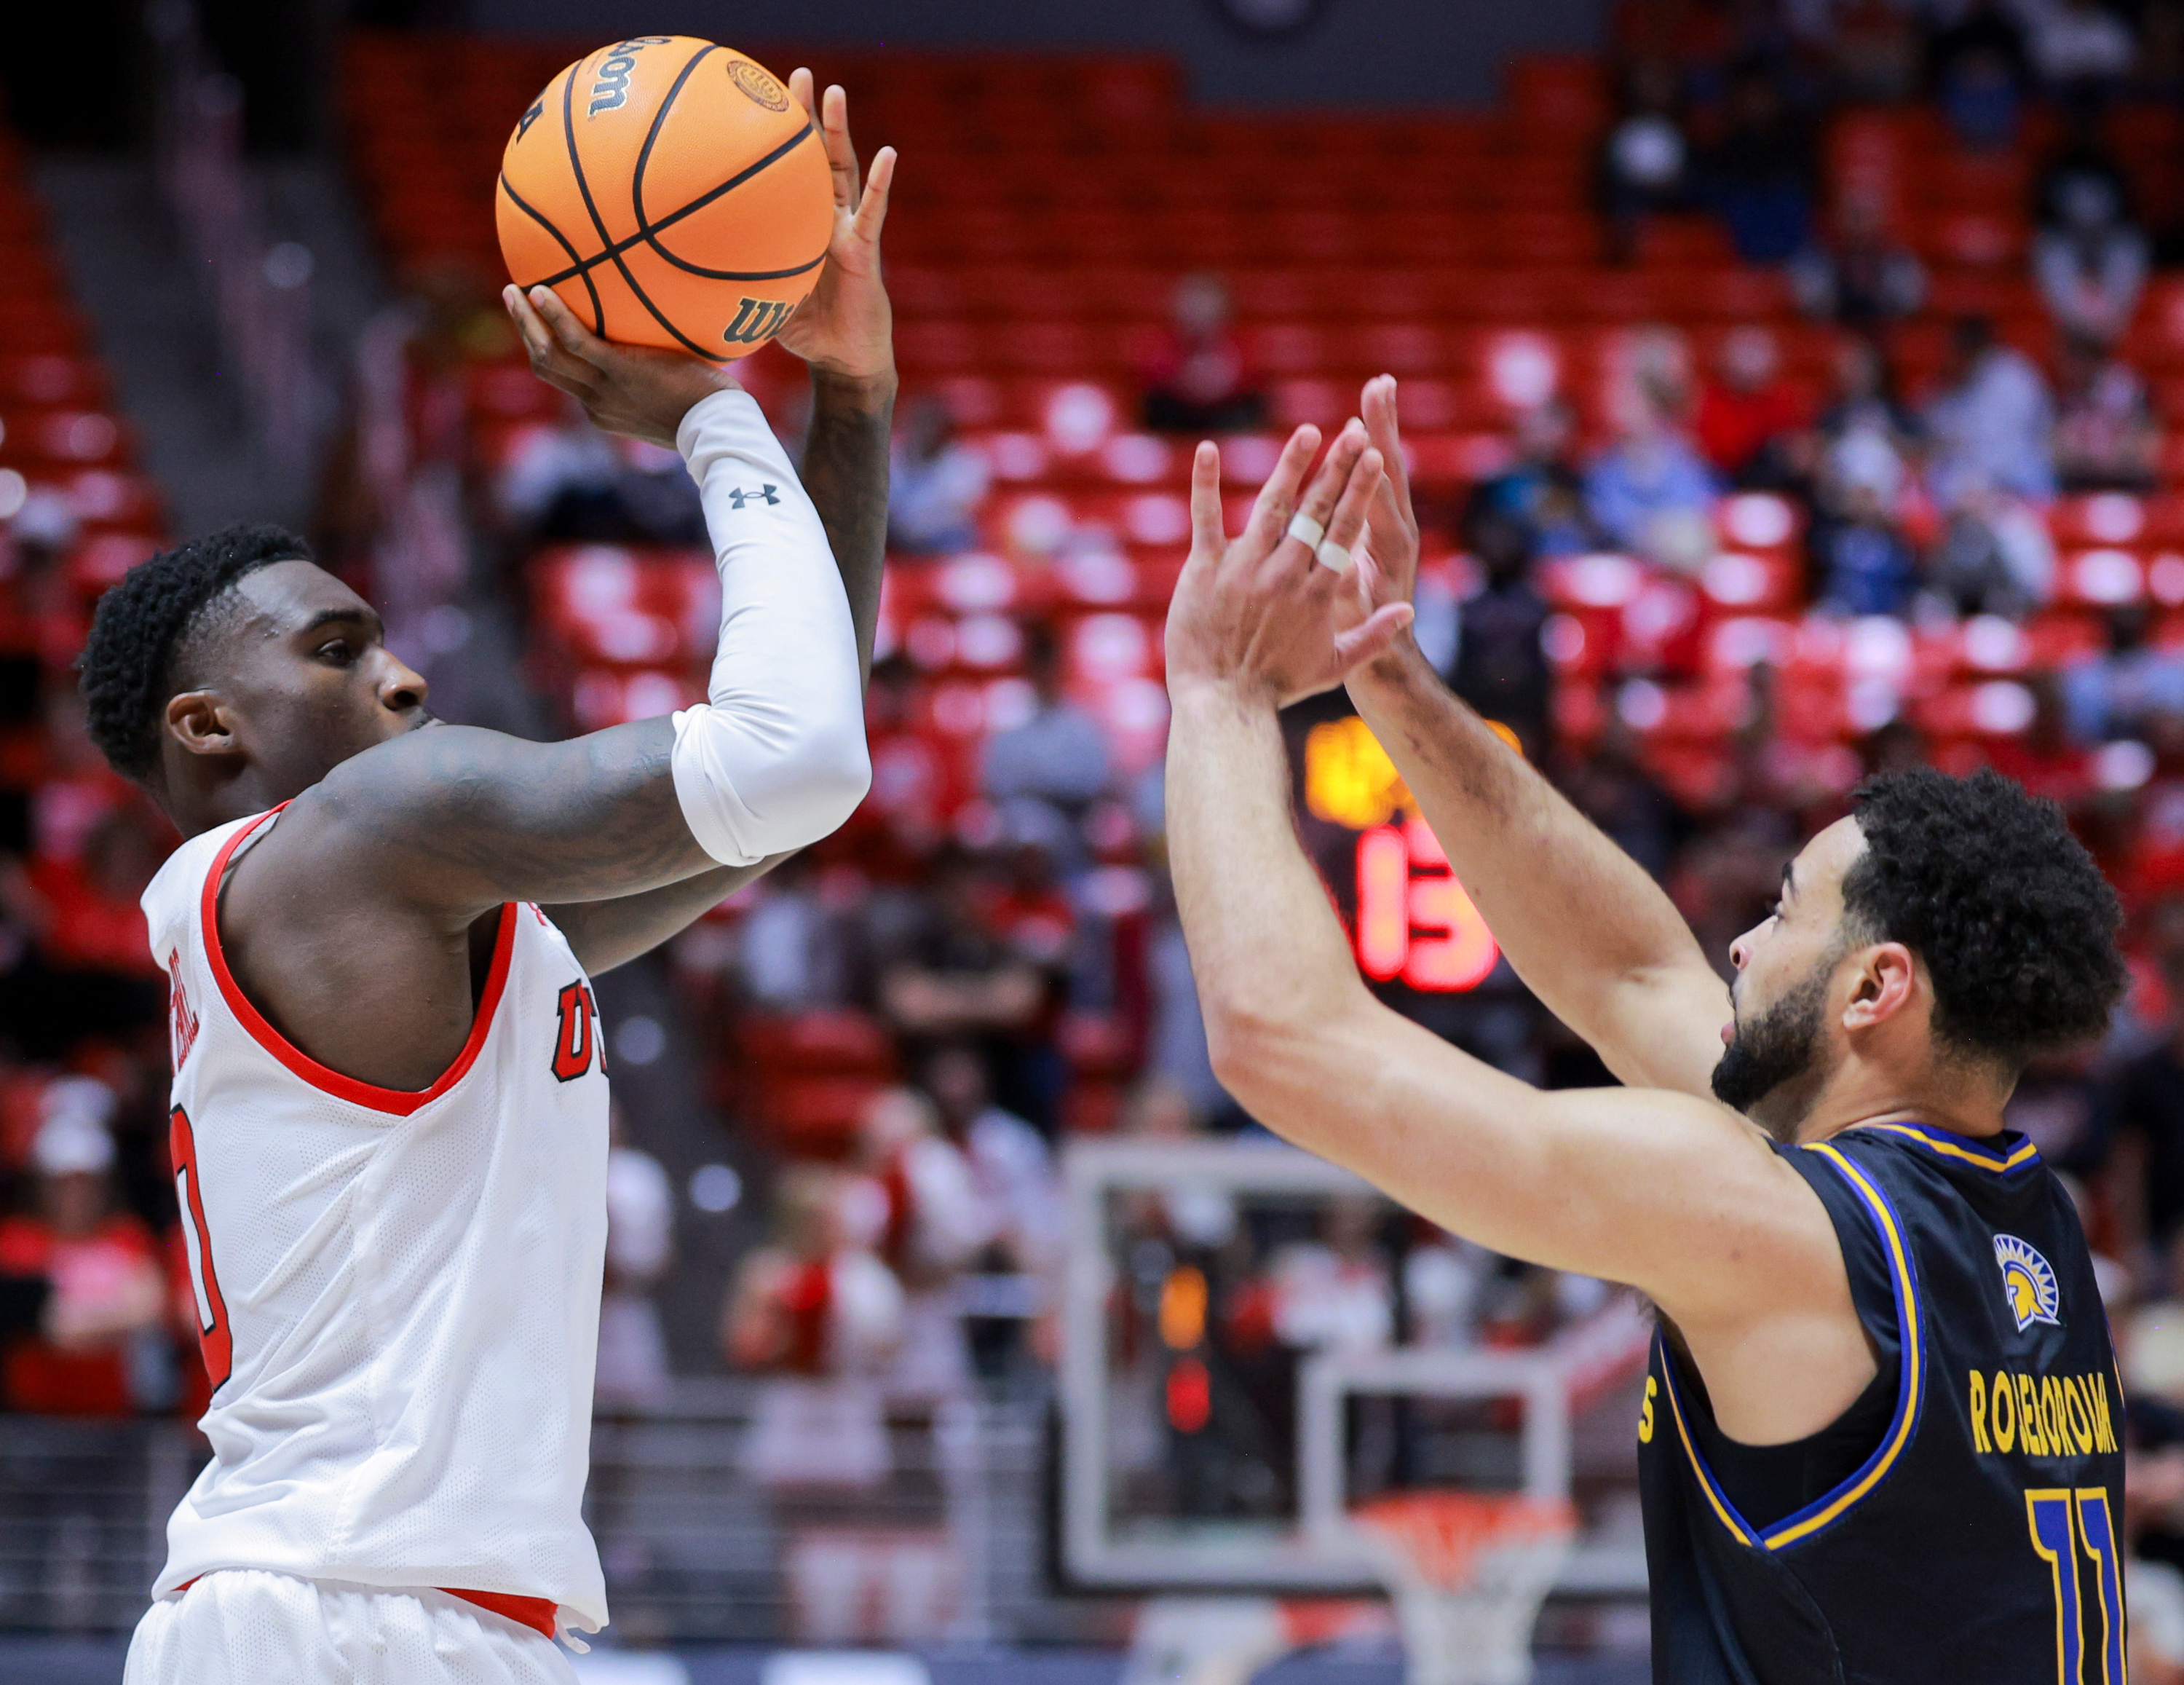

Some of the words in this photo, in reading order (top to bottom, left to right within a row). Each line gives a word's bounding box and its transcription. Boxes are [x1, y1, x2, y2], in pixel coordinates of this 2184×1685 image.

[723, 296, 808, 343] Wi
[551, 978, 609, 1083] U
[2024, 1487, 2127, 1685] 11
